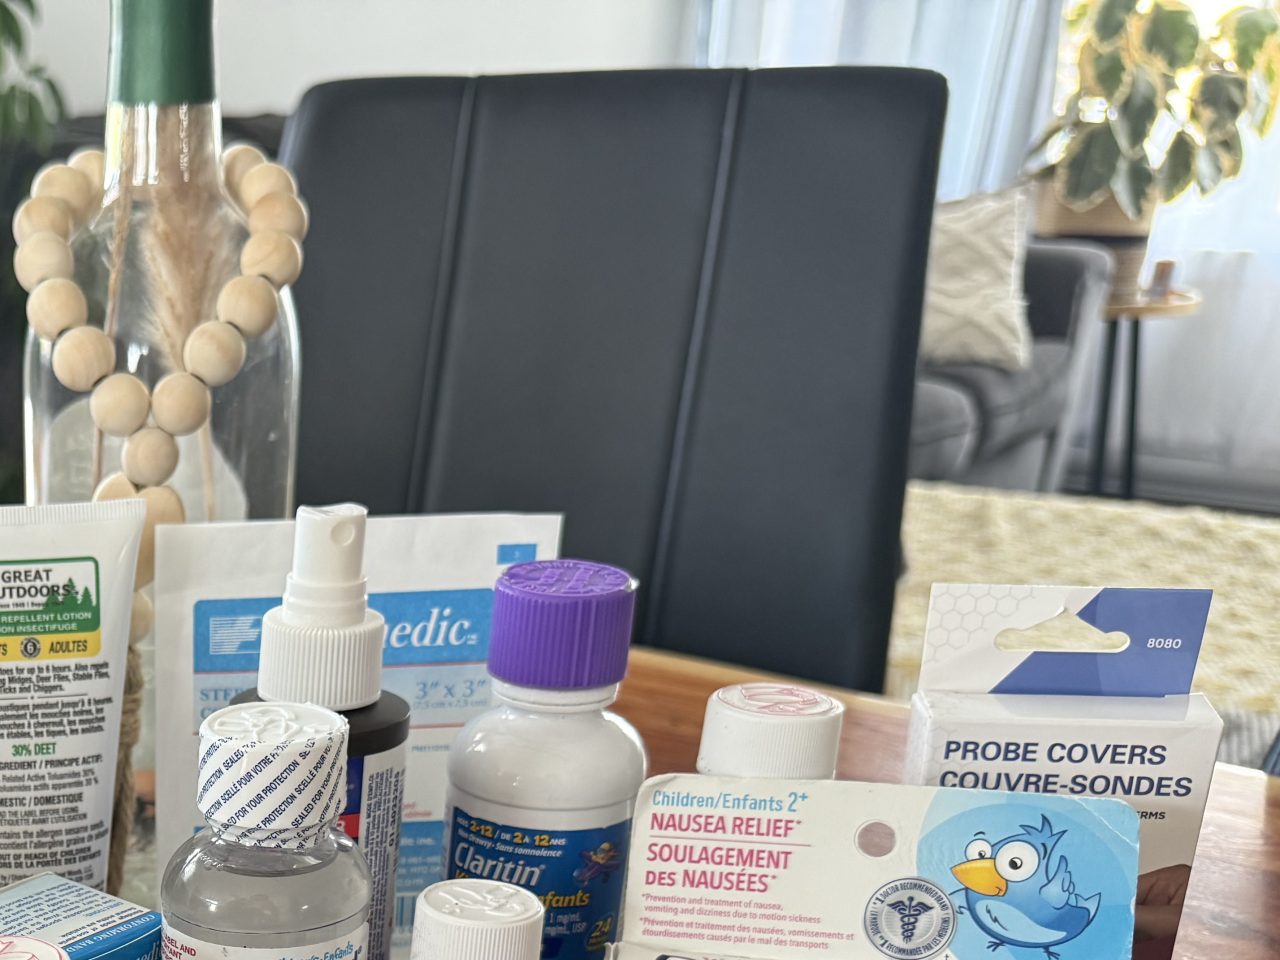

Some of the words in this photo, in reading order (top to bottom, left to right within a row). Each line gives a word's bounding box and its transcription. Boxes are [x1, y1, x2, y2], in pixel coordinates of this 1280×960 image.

[1, 569, 52, 583] GREAT
[1, 614, 55, 623] REPELLENT
[57, 612, 92, 621] LOTION
[17, 622, 78, 633] INSECTIFUGE
[383, 607, 471, 649] edic
[49, 640, 88, 653] ADULTES
[1146, 637, 1182, 650] 8080
[12, 744, 32, 757] 30%
[34, 743, 57, 756] DEET
[943, 740, 1039, 763] PROBE
[1047, 742, 1167, 765] COVERS
[45, 758, 80, 769] PRINCIPE
[939, 770, 1193, 798] COUVRE-SONDES
[34, 793, 83, 806] DOMESTIQUE
[234, 810, 248, 827] FOR
[246, 792, 265, 814] YOUR
[262, 762, 300, 797] PROTECTION
[653, 790, 783, 812] Children/Enfants
[650, 813, 726, 834] NAUSEA
[454, 841, 541, 887] Claritin
[646, 843, 792, 870] SOULAGEMENT
[645, 870, 676, 887] DES
[644, 905, 678, 917] vomiting
[680, 907, 695, 916] and
[696, 908, 730, 919] dizziness
[732, 909, 747, 918] due
[749, 911, 757, 919] to
[758, 912, 787, 922] motion
[788, 914, 821, 924] sickness
